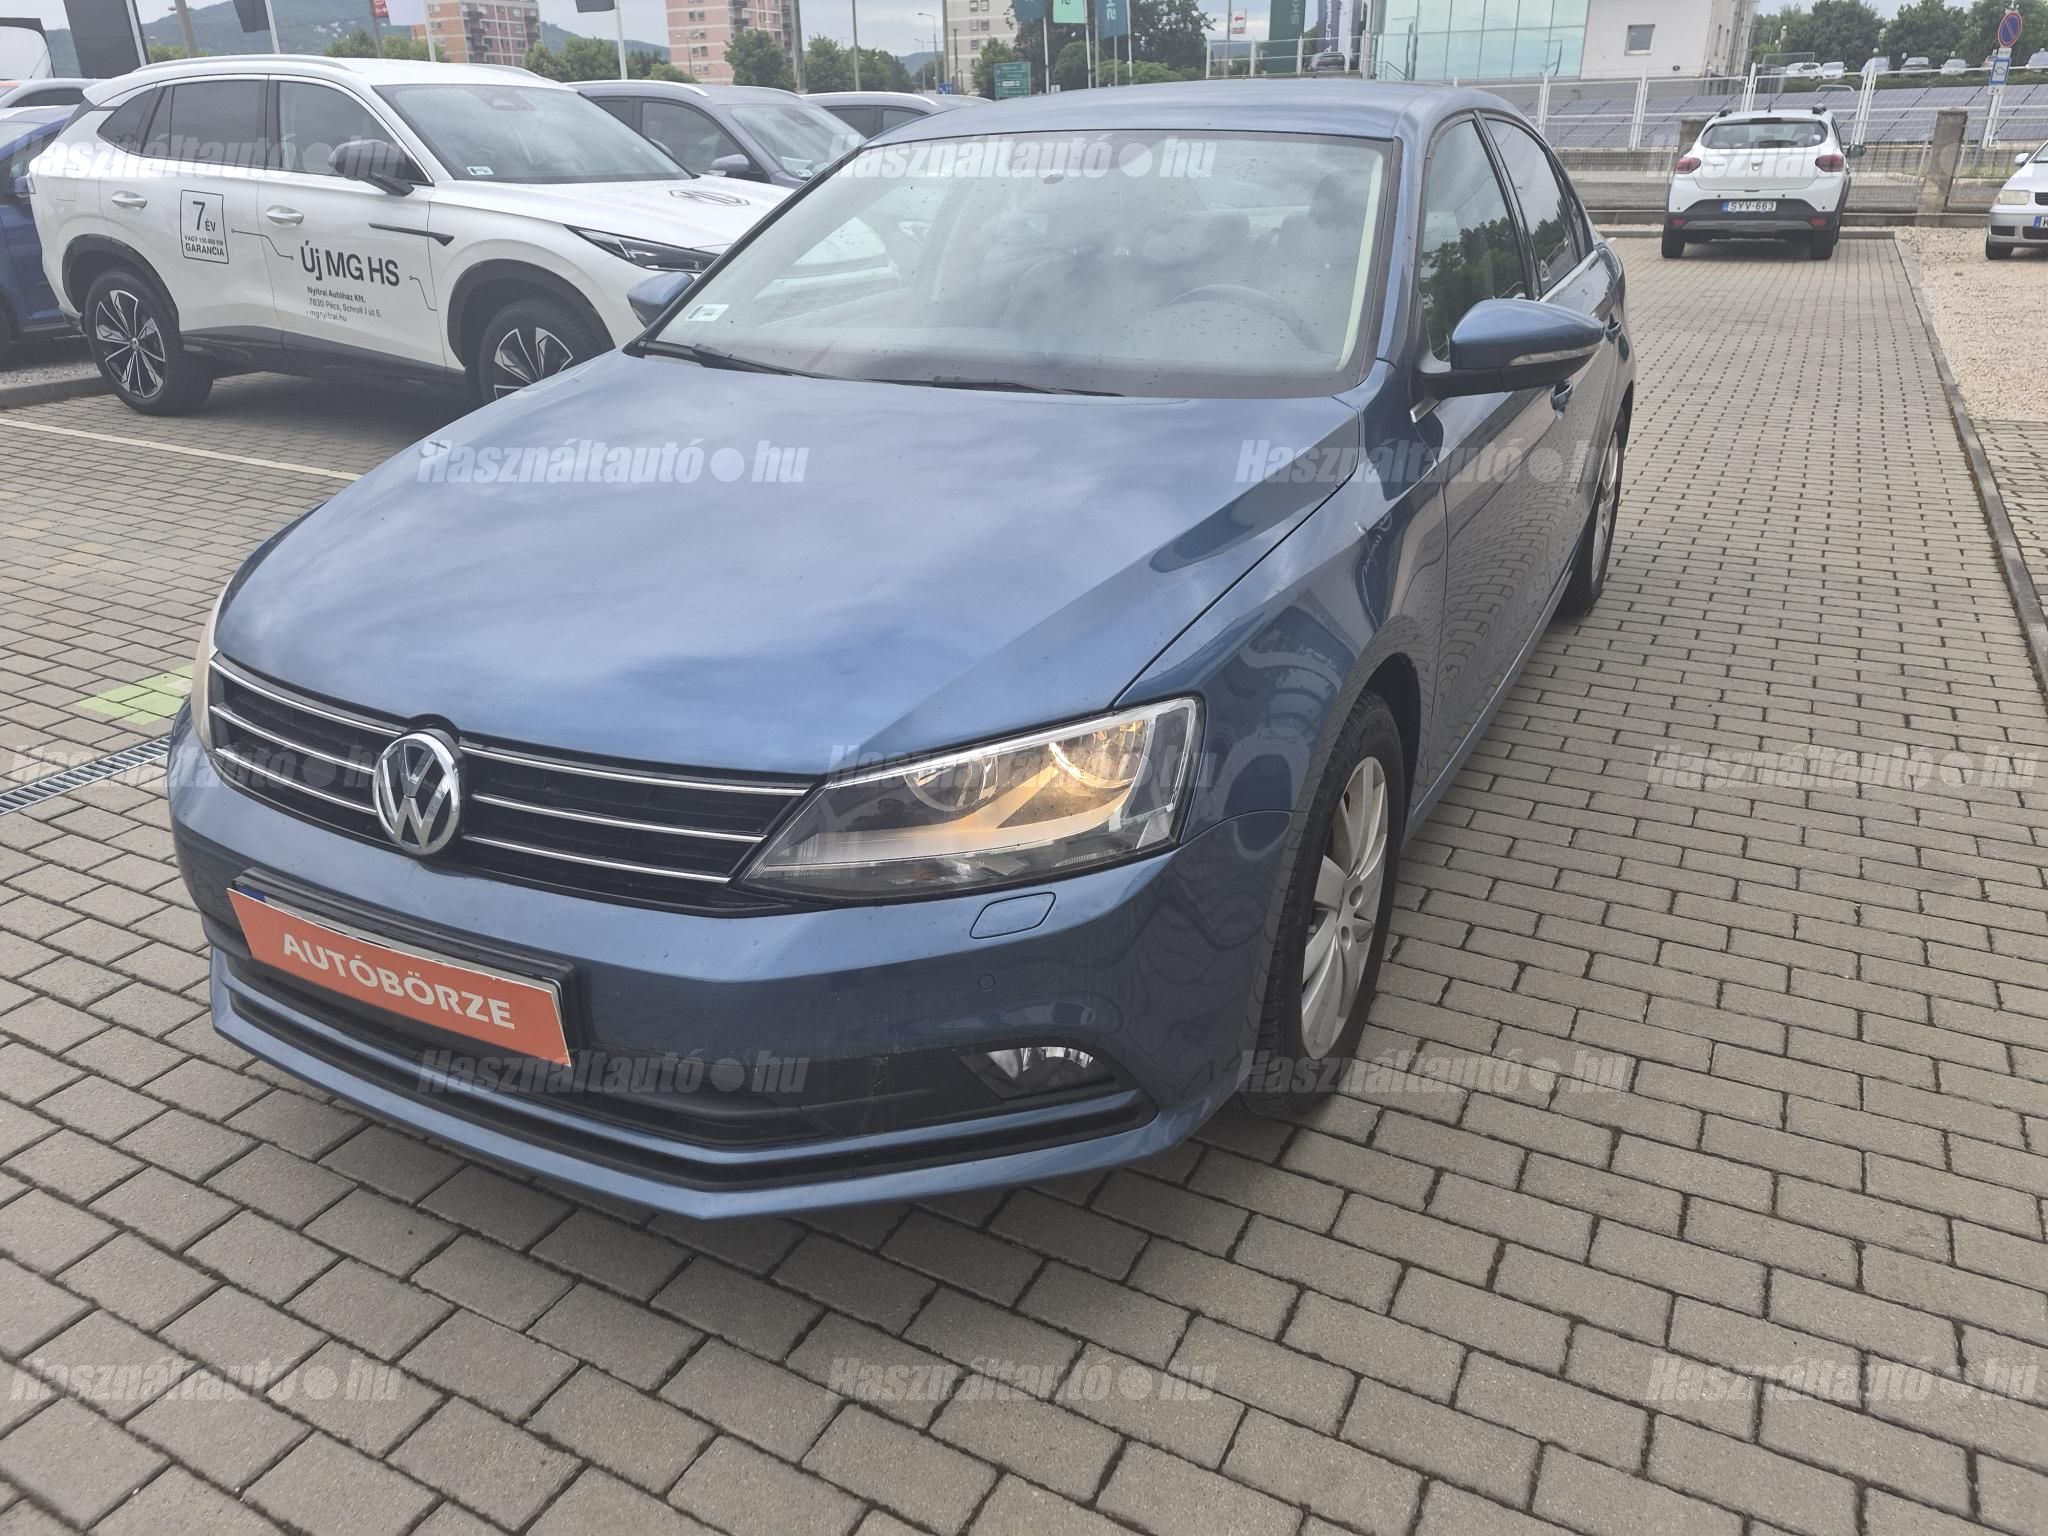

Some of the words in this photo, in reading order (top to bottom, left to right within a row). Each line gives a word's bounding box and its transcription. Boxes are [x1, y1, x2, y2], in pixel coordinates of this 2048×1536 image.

[192, 200, 206, 231] 7
[205, 217, 216, 232] ÉV
[185, 242, 225, 257] GARANCIA
[300, 240, 323, 281] Új
[325, 249, 364, 281] MG
[367, 256, 400, 287] HS
[283, 933, 515, 1030] AUTÓBÖRZE
